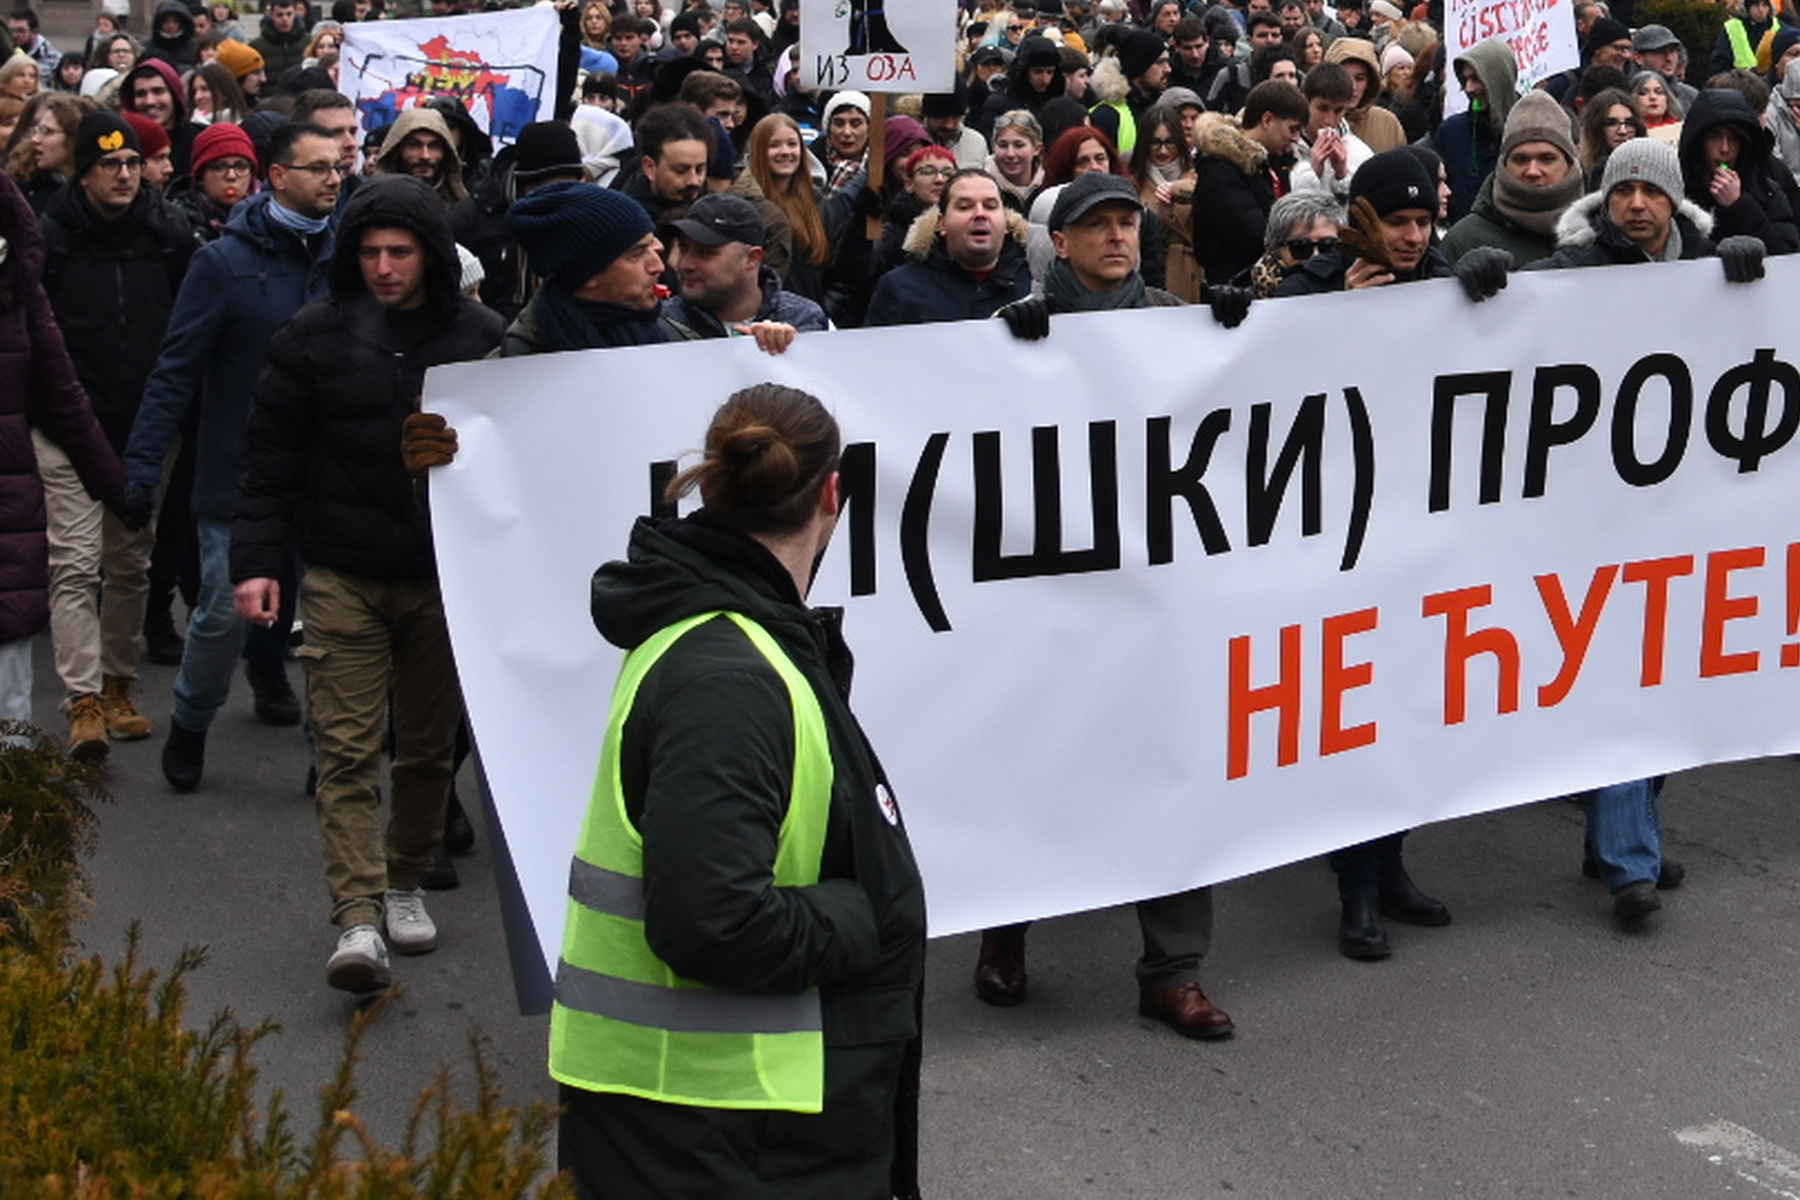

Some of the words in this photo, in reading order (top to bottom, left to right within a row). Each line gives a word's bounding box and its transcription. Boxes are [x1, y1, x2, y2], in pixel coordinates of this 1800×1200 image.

[816, 54, 850, 87] ИЗ
[866, 55, 917, 82] ОЗА
[1226, 605, 1379, 781] НЕ
